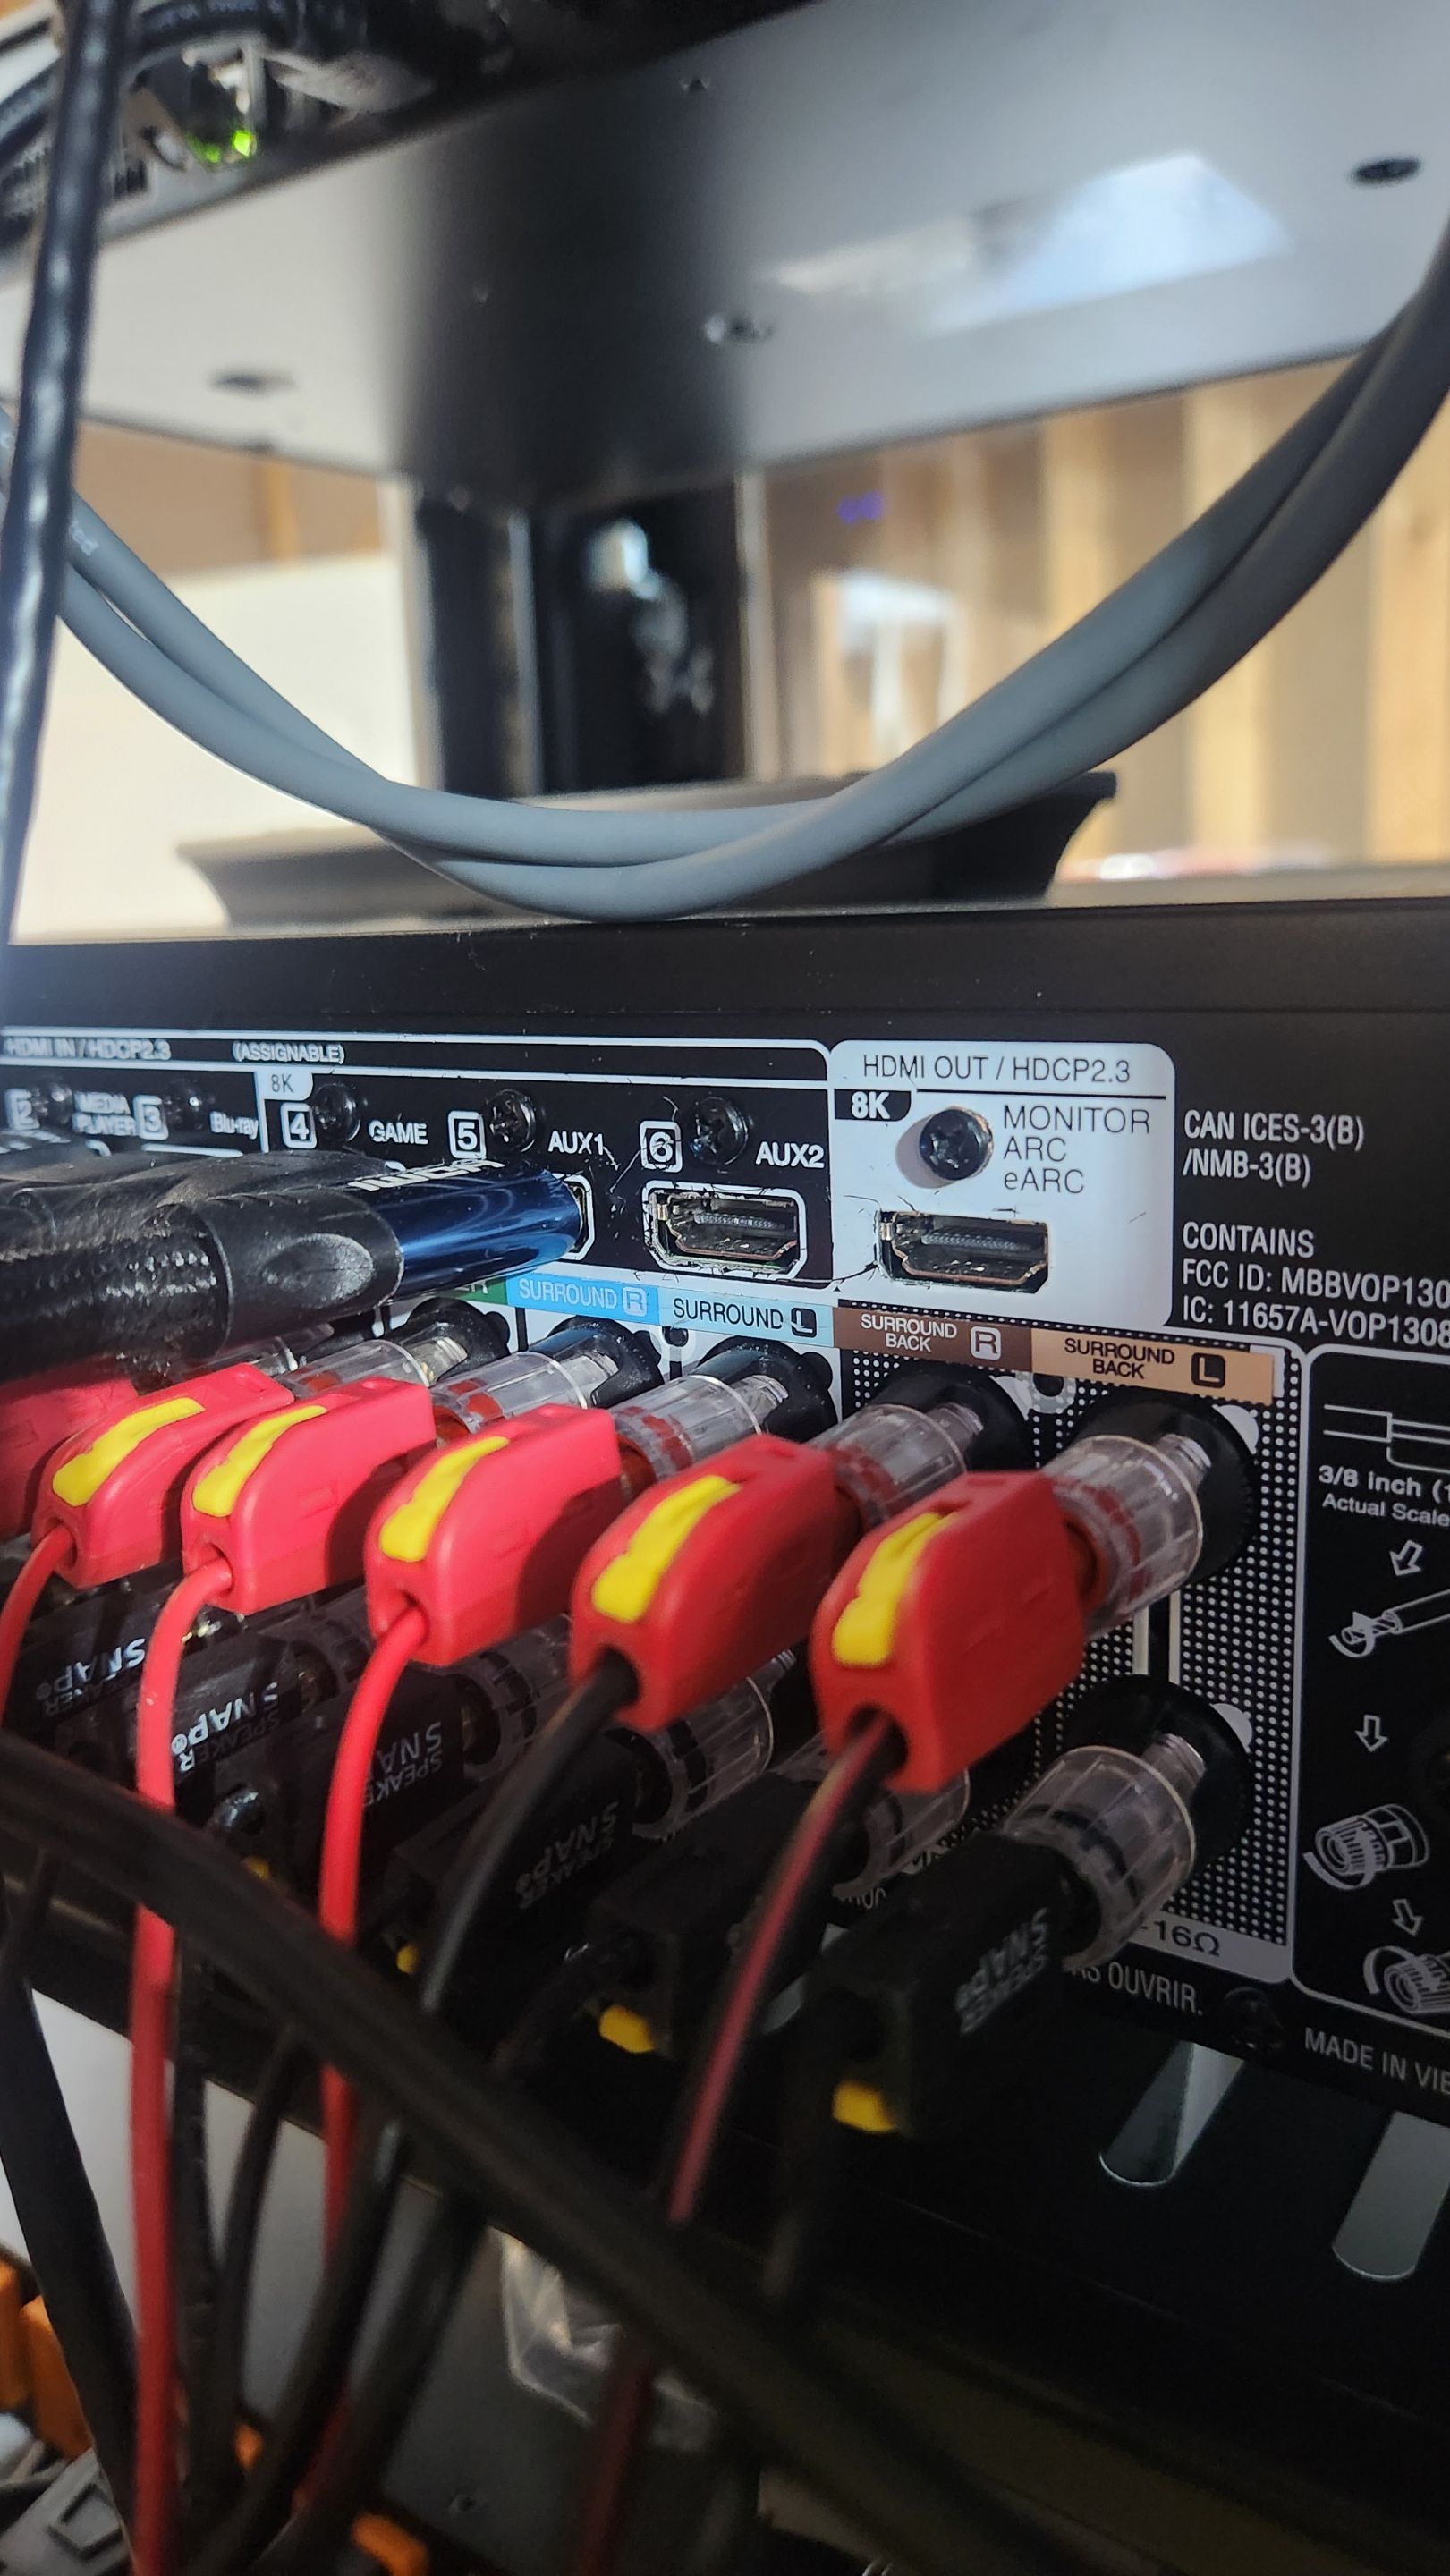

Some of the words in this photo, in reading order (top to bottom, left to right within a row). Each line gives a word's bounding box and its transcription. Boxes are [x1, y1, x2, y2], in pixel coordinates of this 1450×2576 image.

[3, 1038, 52, 1057] HDMI
[54, 1038, 75, 1058] IN
[88, 1039, 172, 1061] HDCP2.3
[233, 1041, 345, 1064] (ASSIGNABLE)
[864, 1054, 925, 1079] HDMI
[935, 1055, 988, 1080] OUT
[996, 1056, 1005, 1081] /
[1013, 1056, 1131, 1083] HDCP2.3
[271, 1074, 294, 1094] 8K
[851, 1090, 891, 1120] 8K
[1003, 1105, 1150, 1134] MONITOR
[210, 1111, 259, 1140] Blu-ray
[369, 1120, 428, 1146] GAME
[457, 1123, 478, 1150] 5
[1183, 1109, 1234, 1140] CAN
[1243, 1112, 1364, 1151] ICES-3(B)
[547, 1130, 605, 1156] AUX1
[649, 1131, 674, 1163] 6
[756, 1140, 825, 1169] AUX2
[1003, 1136, 1066, 1162] ARC
[1004, 1168, 1085, 1194] eARC
[1182, 1148, 1311, 1188] /NMB-3(B)
[1183, 1221, 1315, 1258] CONTAINS
[1183, 1258, 1229, 1289] FCC
[1238, 1264, 1272, 1293] ID:
[518, 1278, 617, 1309] SURROUND
[624, 1288, 646, 1314] R
[1183, 1295, 1214, 1324] IC:
[673, 1297, 784, 1330] SURROUND
[793, 1309, 815, 1335] L
[861, 1313, 957, 1340] SURROUND
[973, 1329, 999, 1357] R
[886, 1331, 932, 1352] BACK
[1064, 1337, 1174, 1365] SURROUND
[1195, 1355, 1222, 1384] L
[1092, 1358, 1144, 1379] BACK
[1318, 1464, 1359, 1487] 3/8
[1368, 1470, 1421, 1498] inch
[1322, 1493, 1386, 1517] Actual
[1391, 1503, 1450, 1527] Scale
[377, 1721, 443, 1769] SNA
[361, 1750, 444, 1809] SPEAKE
[1107, 1961, 1203, 2016] OUVRIR.
[1304, 2027, 1374, 2070] MADE
[1382, 2051, 1406, 2081] IN
[1414, 2060, 1450, 2096] VIE
